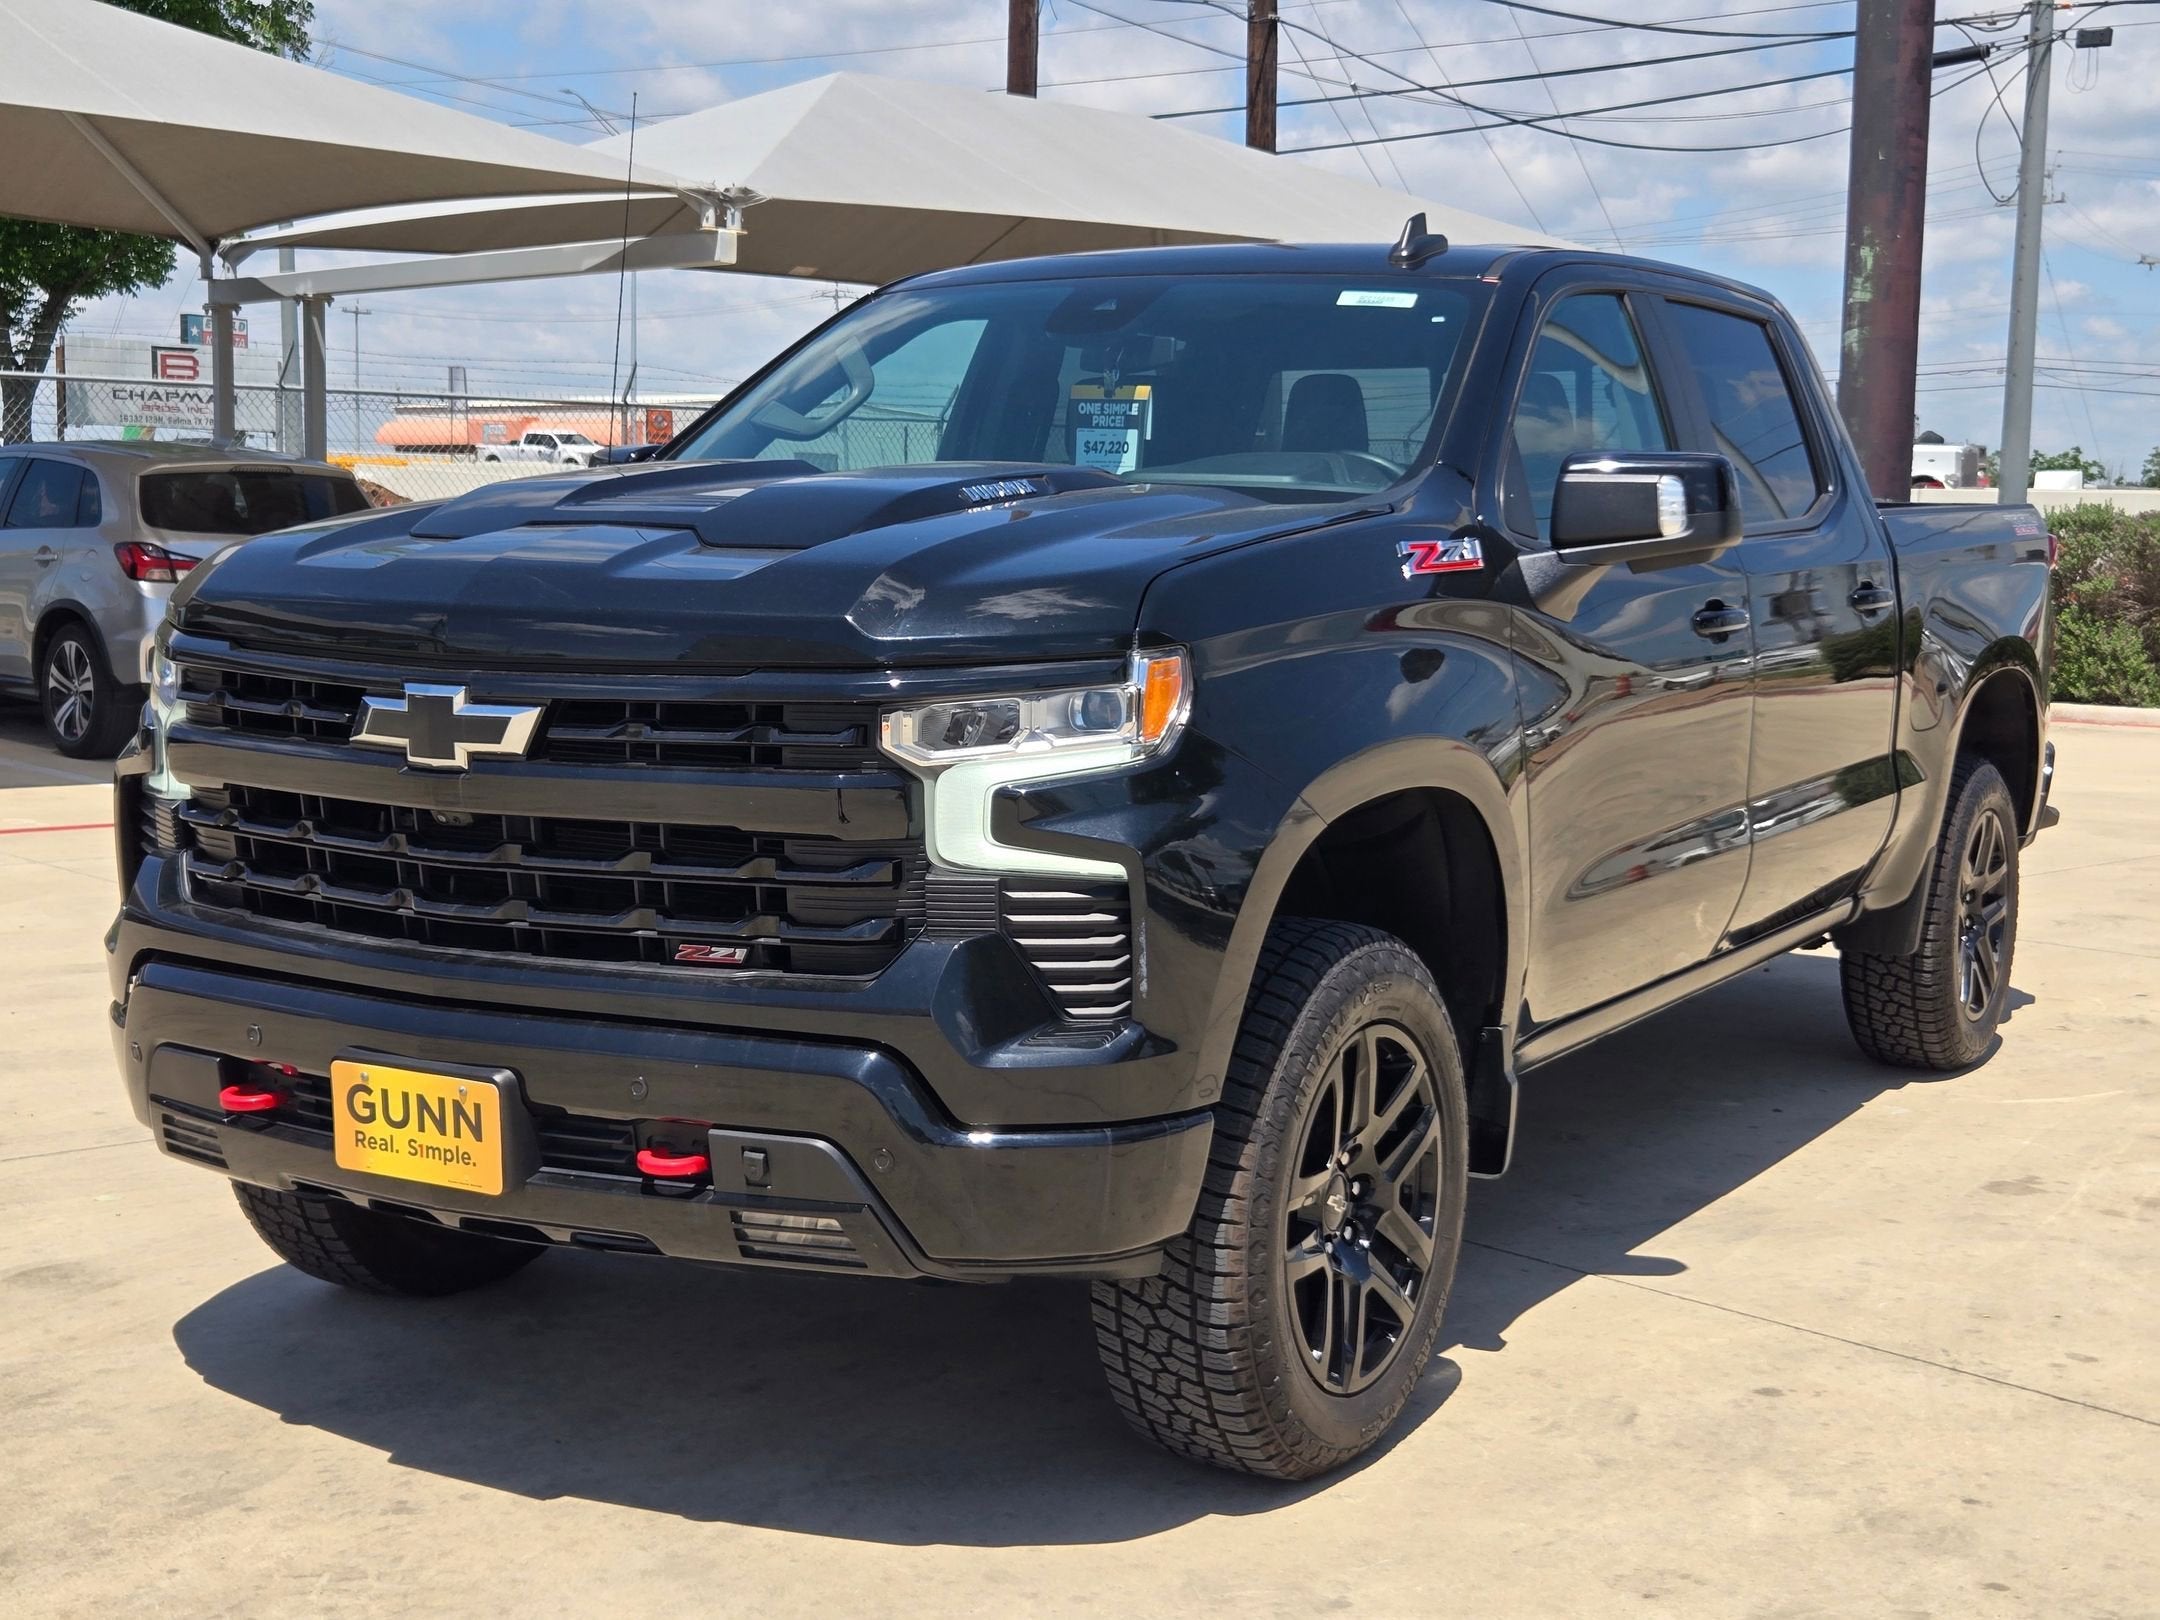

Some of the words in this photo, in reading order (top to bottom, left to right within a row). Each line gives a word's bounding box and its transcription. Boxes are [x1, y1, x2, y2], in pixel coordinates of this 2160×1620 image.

[1078, 402, 1101, 415] ONE
[1103, 402, 1139, 416] SIMPLE
[1092, 415, 1125, 428] PRICE!
[1083, 440, 1129, 456] $47,220
[1396, 537, 1485, 579] Z71
[674, 944, 748, 964] Z71
[346, 1083, 483, 1143] GUNN
[354, 1129, 400, 1154] Real.
